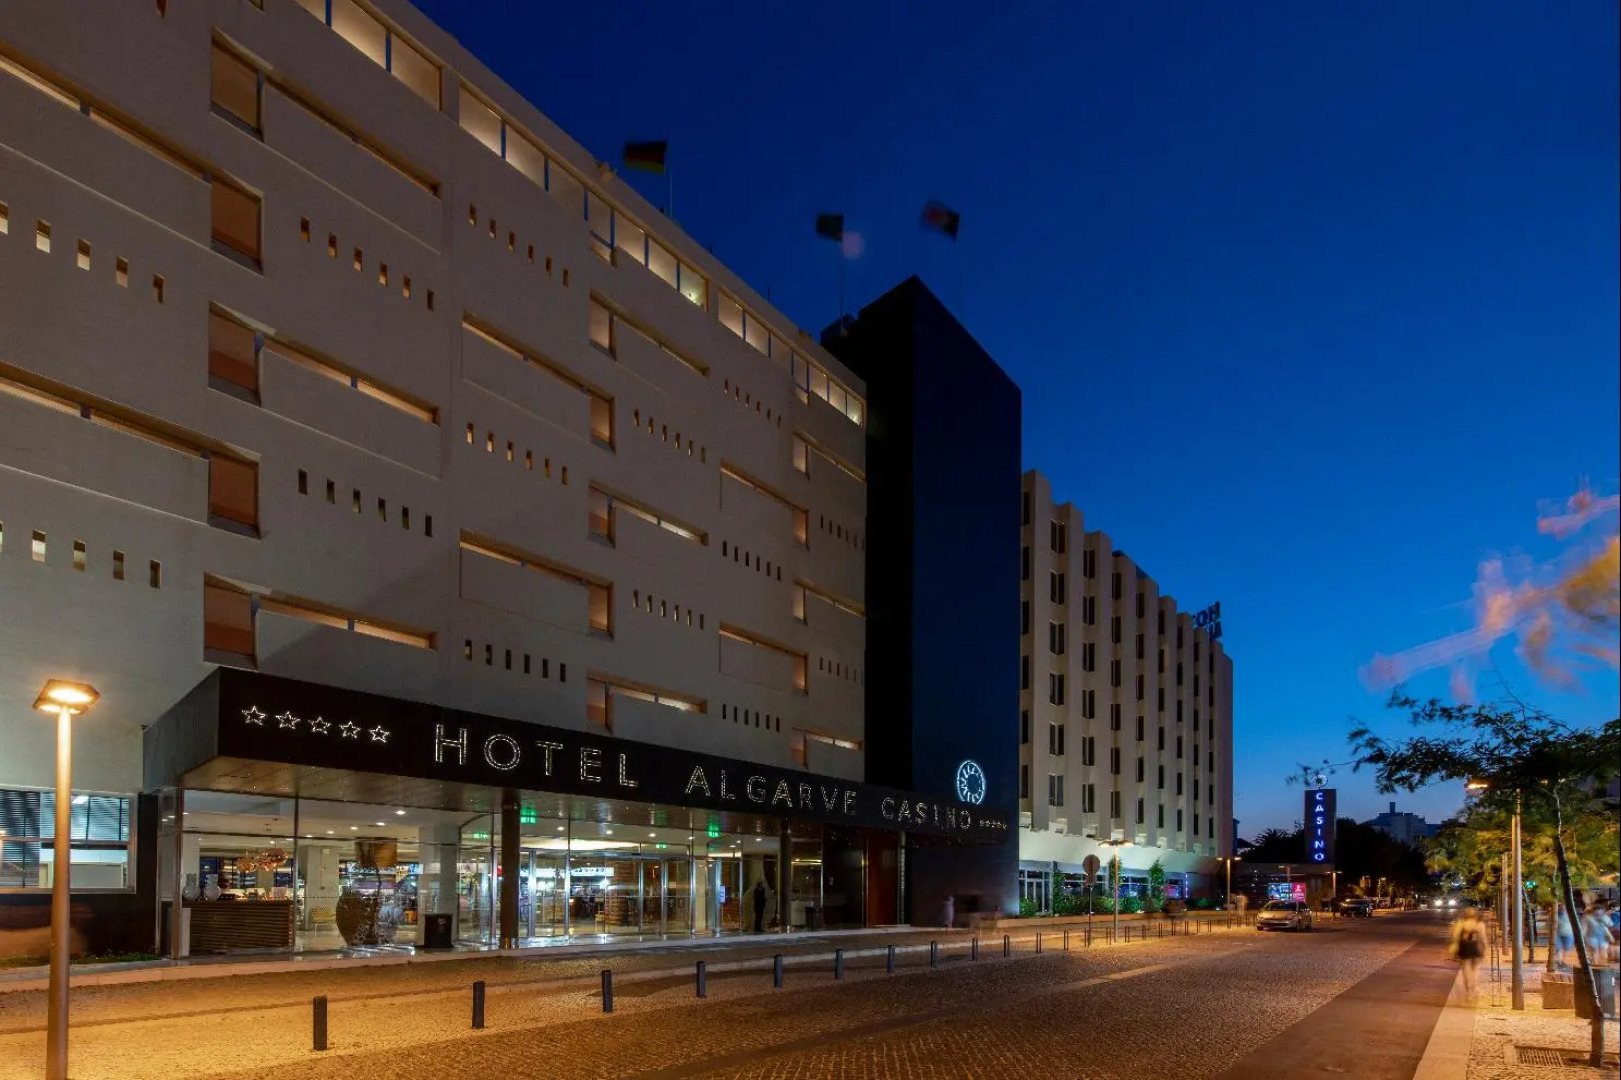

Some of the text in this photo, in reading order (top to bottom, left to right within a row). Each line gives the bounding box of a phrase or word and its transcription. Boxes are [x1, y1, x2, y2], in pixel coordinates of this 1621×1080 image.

[434, 723, 971, 830] HOTEL ALGARVE CASINO
[1314, 792, 1325, 861] CASINO
